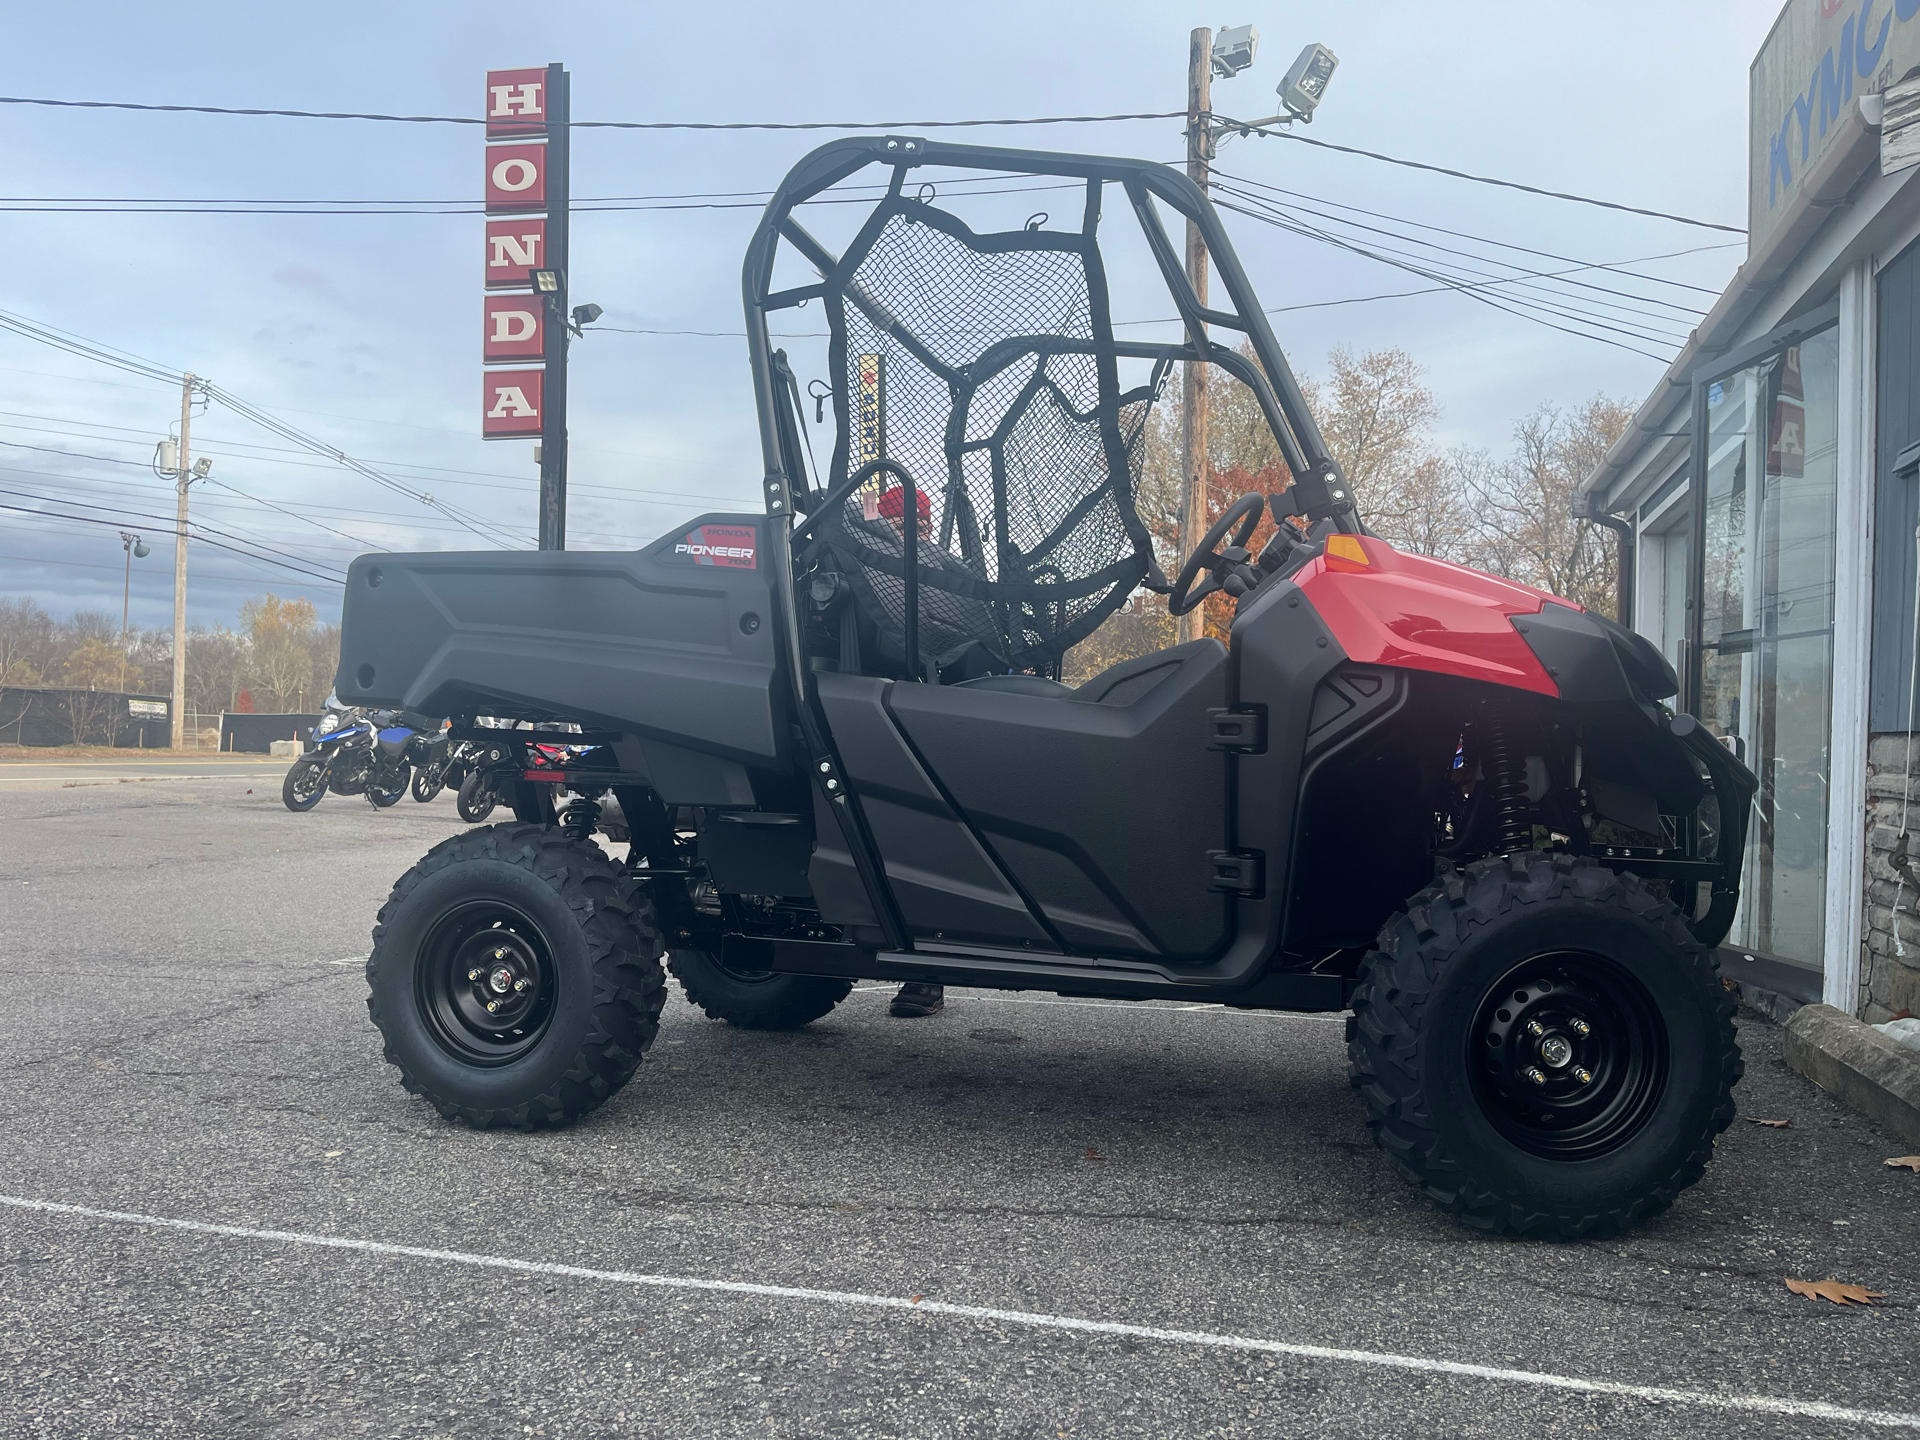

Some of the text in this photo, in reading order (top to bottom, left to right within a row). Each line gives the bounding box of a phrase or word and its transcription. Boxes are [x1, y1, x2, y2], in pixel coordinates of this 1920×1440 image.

[1769, 0, 1920, 210] KYMC
[487, 83, 542, 418] HONDA
[706, 528, 752, 538] HONDA
[674, 543, 754, 558] PIONEER
[726, 558, 752, 566] 700
